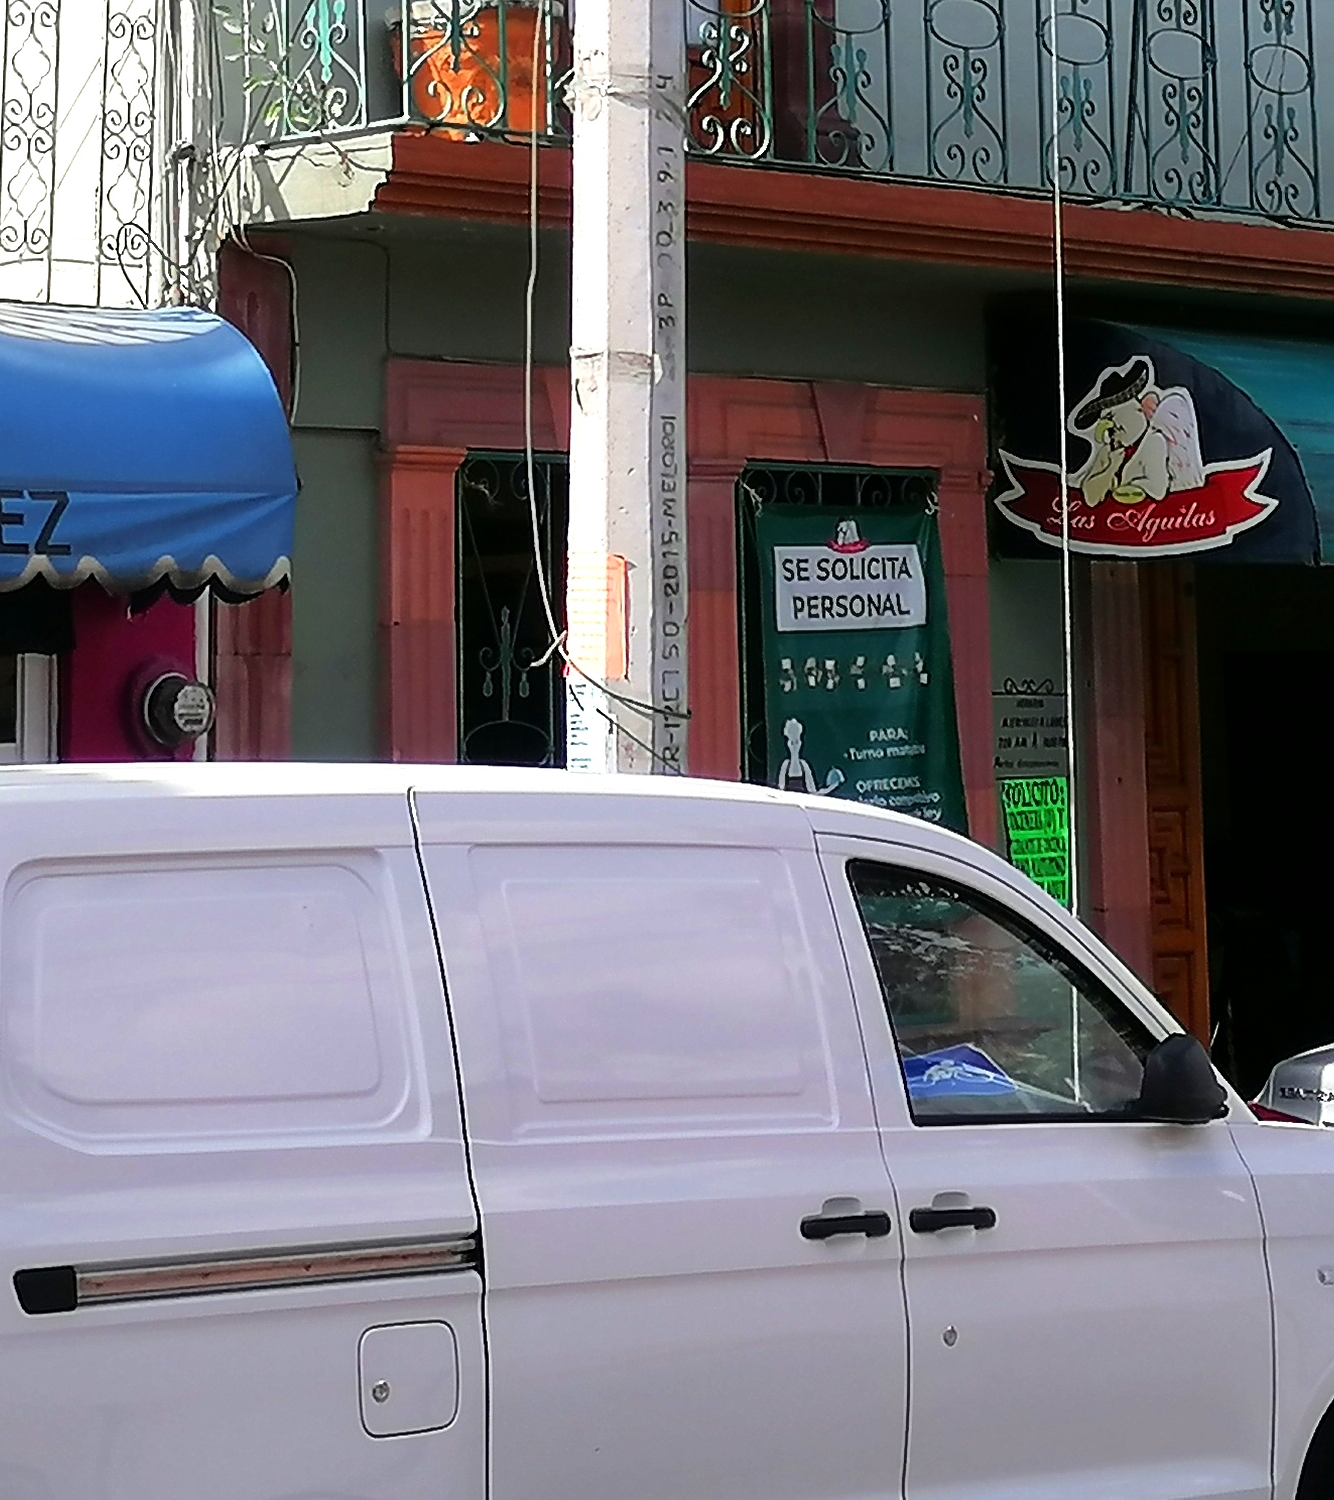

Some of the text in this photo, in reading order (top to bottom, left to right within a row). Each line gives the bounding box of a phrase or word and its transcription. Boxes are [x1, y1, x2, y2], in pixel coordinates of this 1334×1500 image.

[1046, 496, 1216, 543] Las Aguilas
[782, 556, 913, 582] SE SOLICITA
[792, 593, 912, 620] PERSONAL
